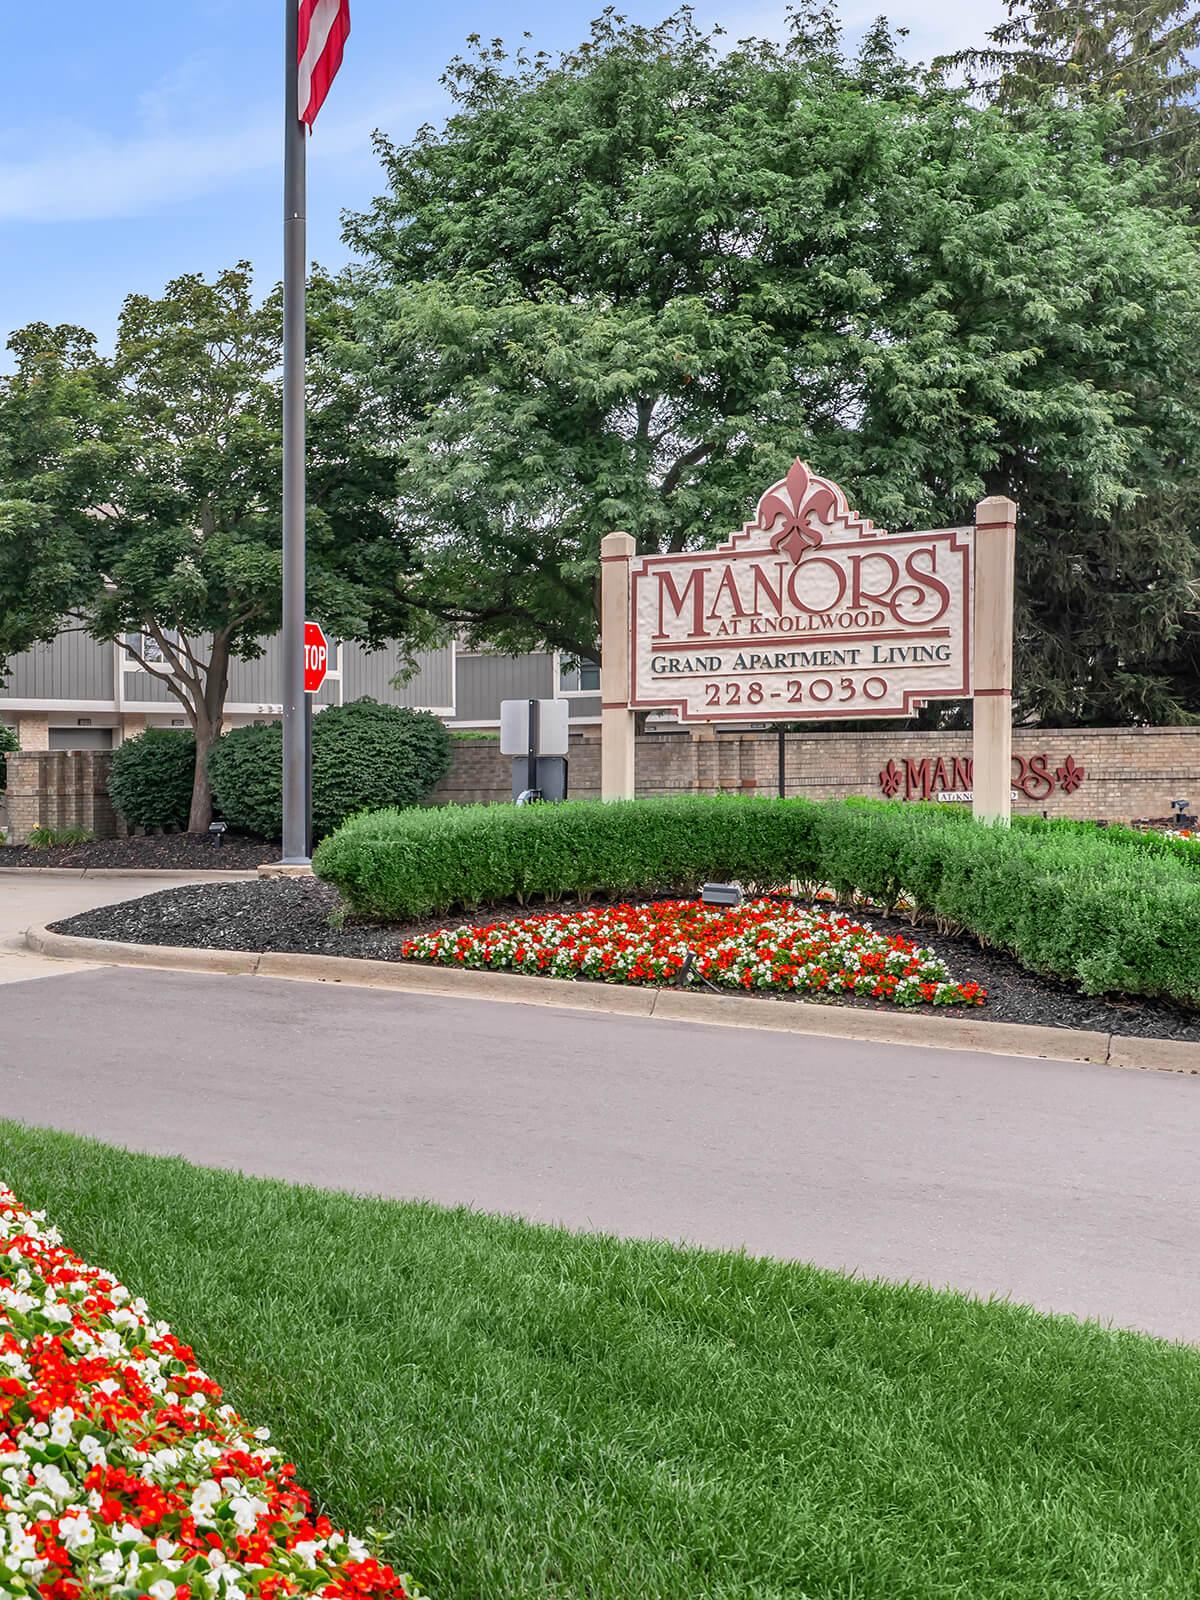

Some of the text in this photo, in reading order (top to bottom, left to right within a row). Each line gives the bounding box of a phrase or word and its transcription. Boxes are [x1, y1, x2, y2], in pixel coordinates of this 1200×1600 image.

[652, 544, 951, 639] MANORS
[716, 610, 885, 636] AT KNOLLWOOD
[304, 644, 326, 671] TOP
[651, 644, 952, 673] GRAND APARTMENT LIVING
[704, 676, 889, 706] 228-2030
[903, 754, 1056, 802] MANRS
